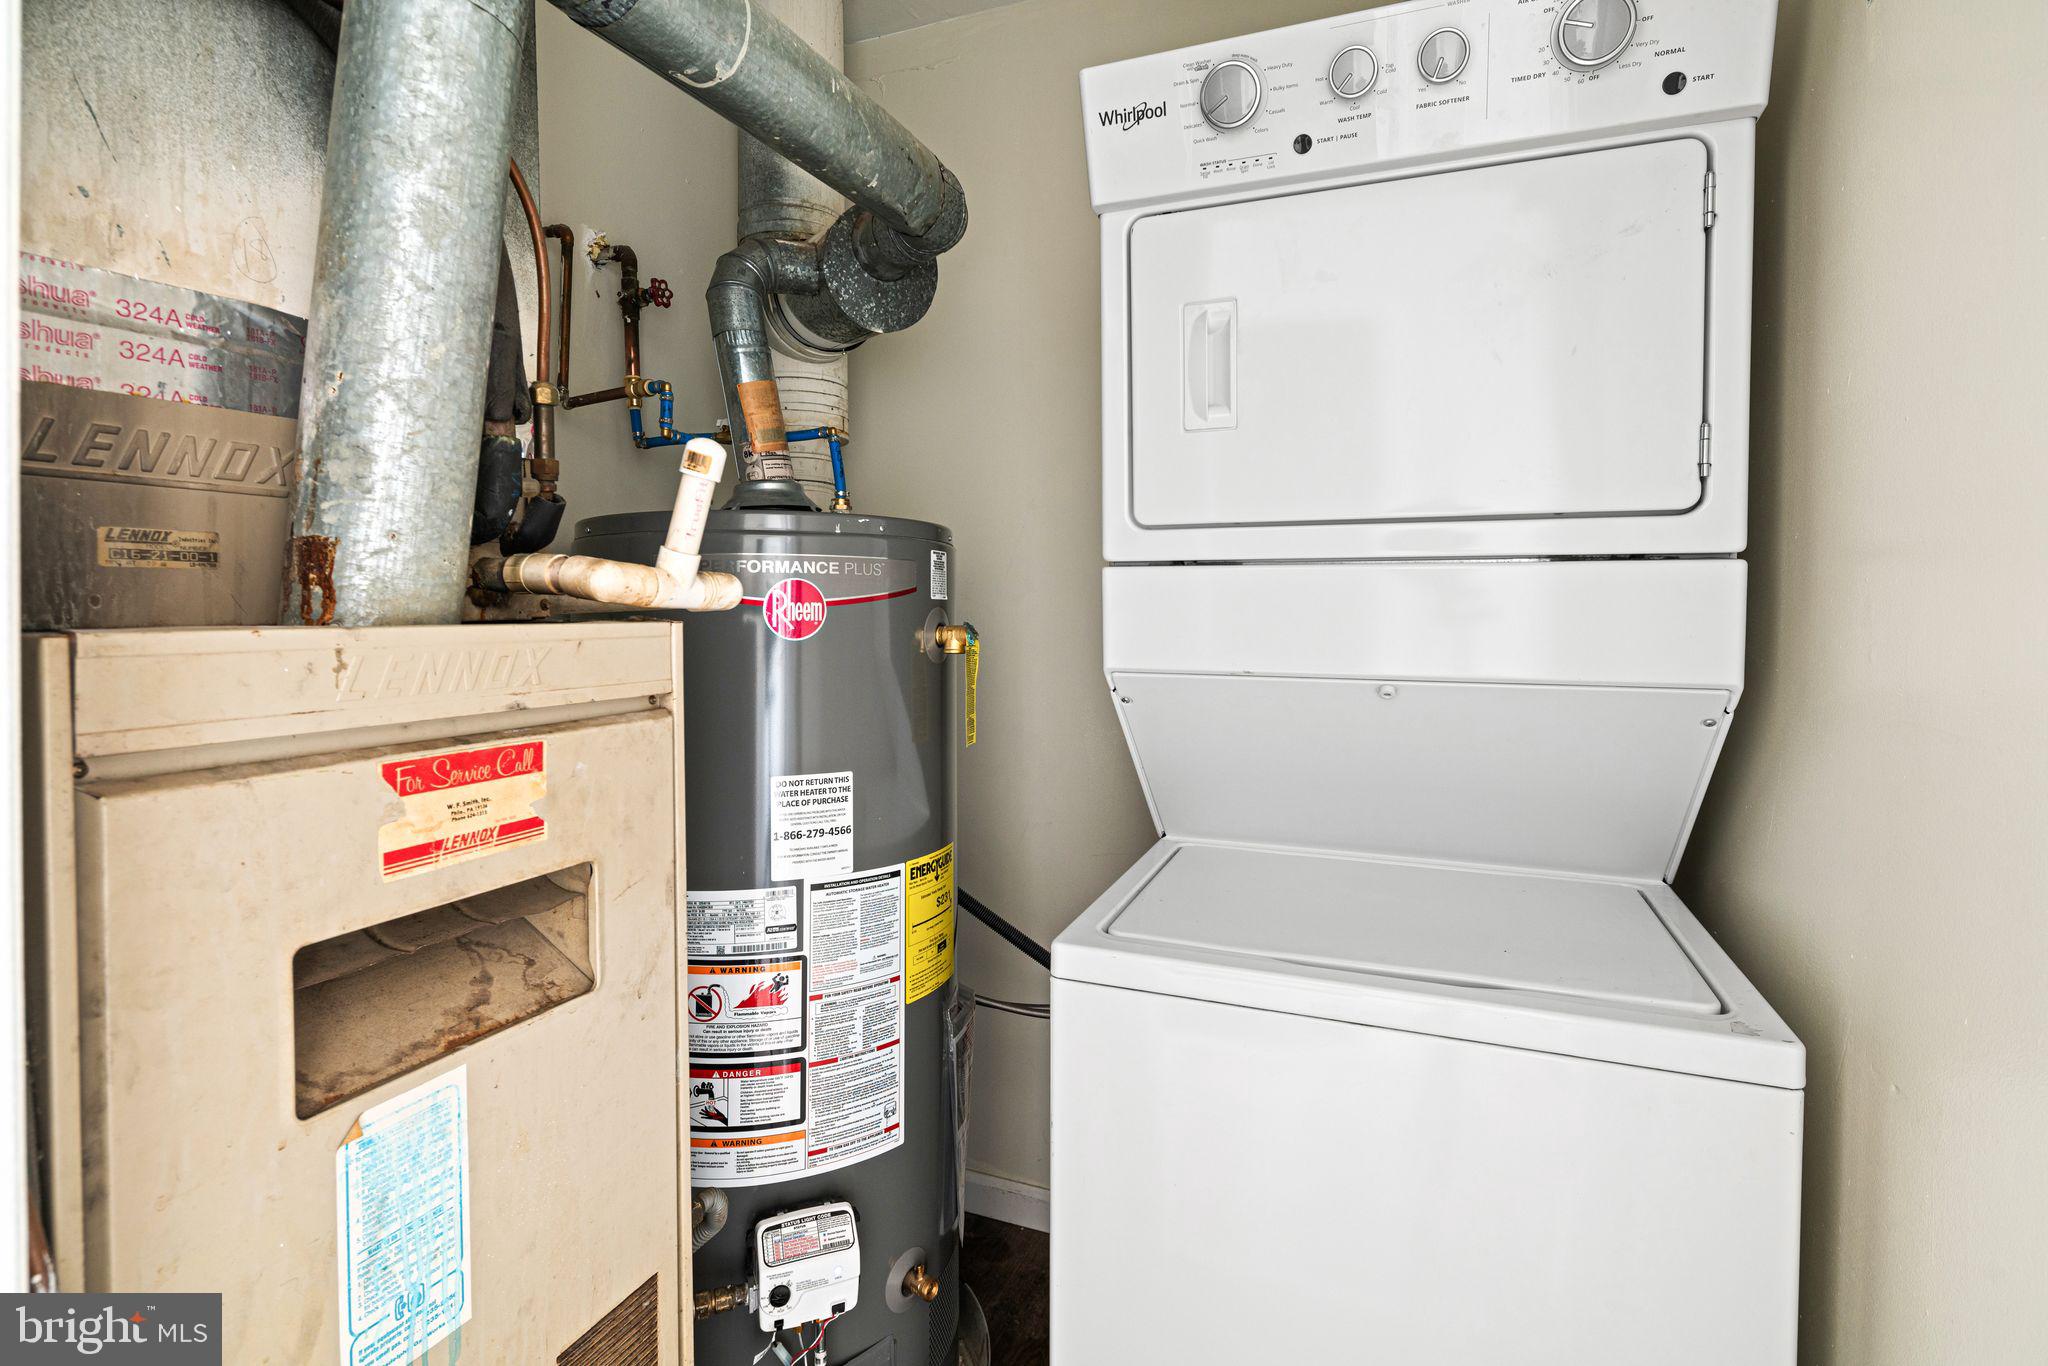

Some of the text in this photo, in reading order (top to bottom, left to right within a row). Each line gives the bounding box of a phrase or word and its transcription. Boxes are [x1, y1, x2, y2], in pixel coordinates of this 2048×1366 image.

[1654, 47, 1686, 57] NORMAL
[1511, 75, 1531, 83] TIMED
[1692, 74, 1715, 82] START
[1416, 96, 1470, 110] FABRIC SOFTENER
[1098, 102, 1167, 128] Whirlpool
[1337, 112, 1372, 124] WASH TEMP
[1316, 132, 1358, 144] START PAUSE
[115, 298, 182, 328] 324A
[185, 313, 205, 322] COLD
[186, 321, 220, 334] WEATHER
[119, 340, 185, 369] 324A
[188, 353, 208, 362] COLD
[189, 362, 223, 373] WEATHER
[189, 394, 208, 402] COLD
[22, 417, 296, 486] LENNOX
[105, 528, 173, 542] LENNOX
[772, 588, 823, 630] Rheem
[336, 648, 550, 702] LENNOX
[395, 748, 534, 796] For Service Call
[788, 779, 804, 787] NOT
[806, 778, 834, 786] RETURN
[800, 788, 827, 796] HEATER
[812, 796, 848, 805] PURCHASE
[442, 826, 497, 851] LENNOX
[773, 825, 852, 841] 1-866-279-4566
[722, 1139, 762, 1147] WARNING
[781, 1220, 800, 1228] STATUS
